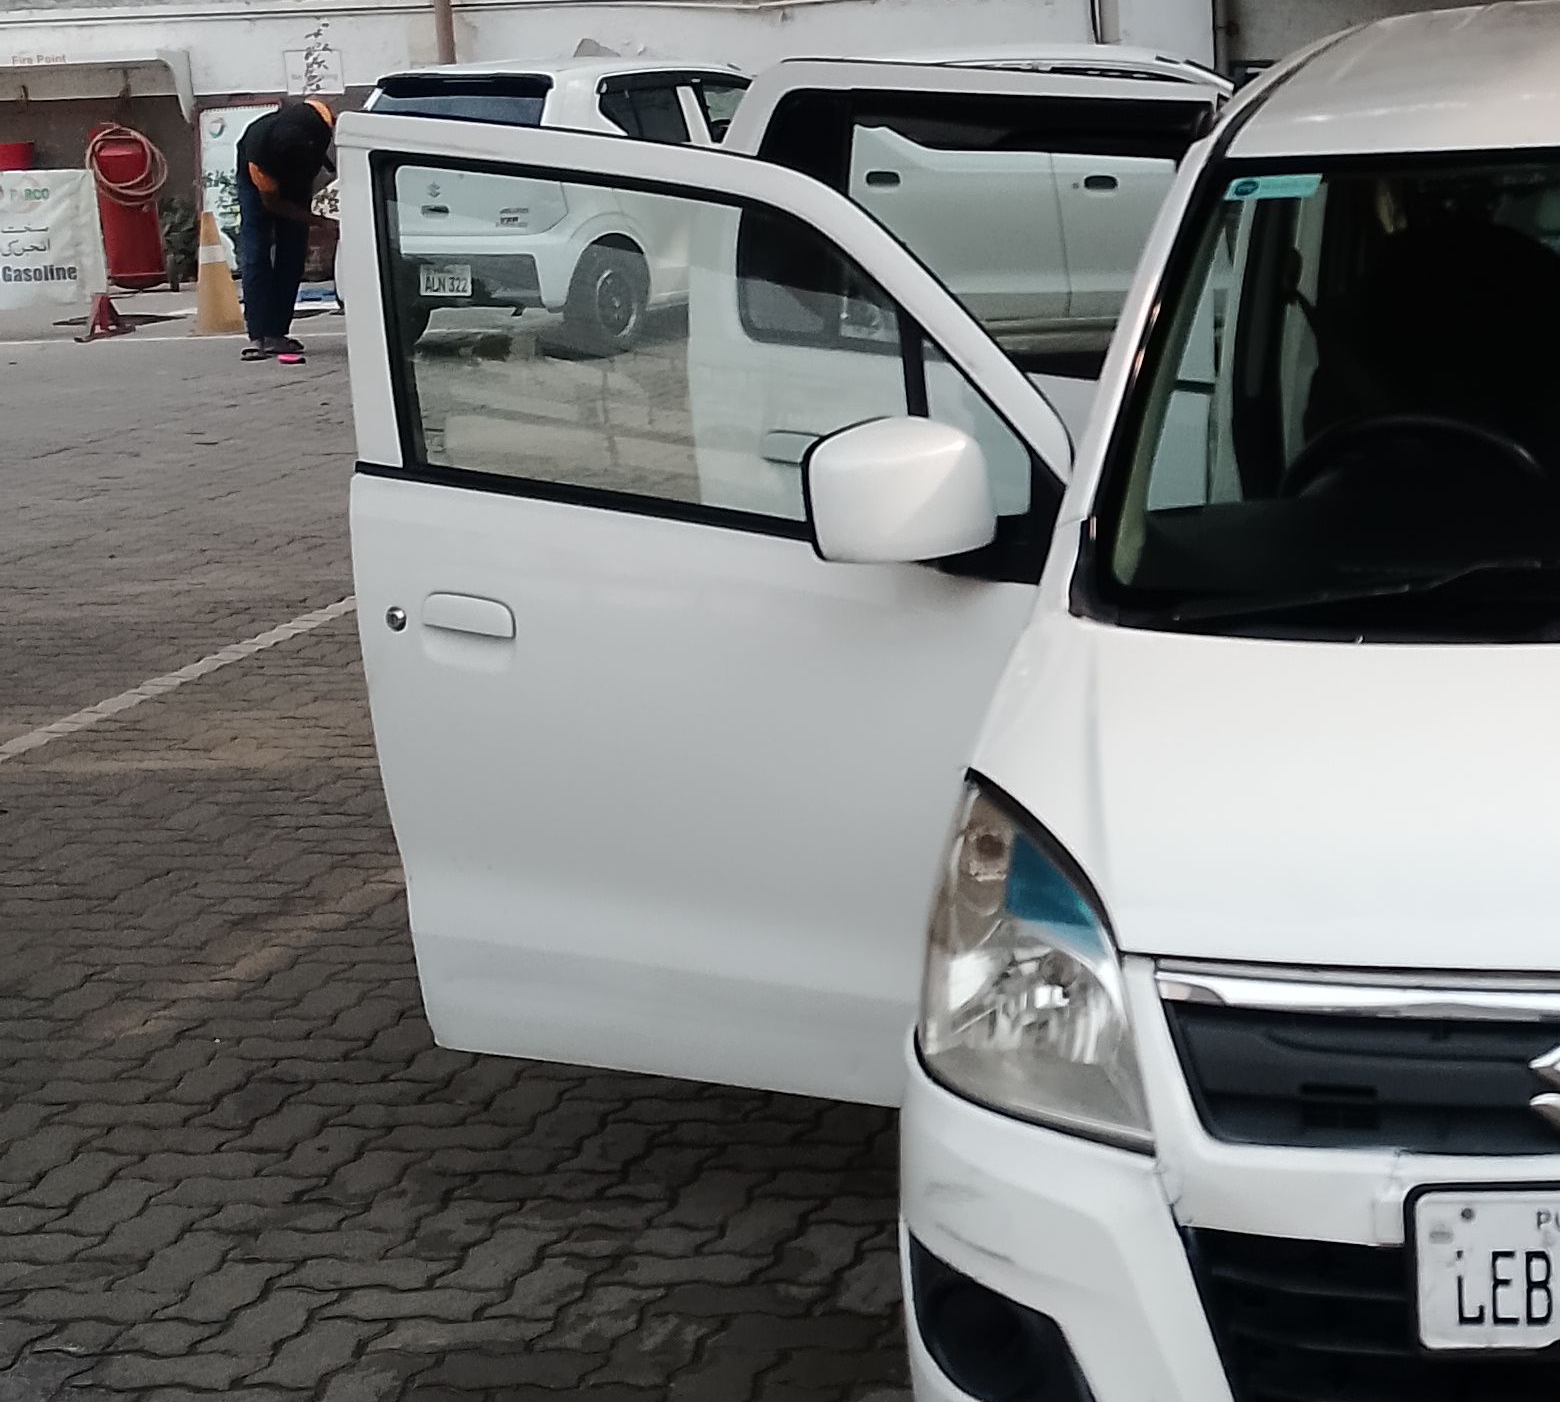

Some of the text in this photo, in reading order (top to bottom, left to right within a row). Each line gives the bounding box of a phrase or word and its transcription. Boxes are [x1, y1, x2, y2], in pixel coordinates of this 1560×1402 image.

[11, 54, 67, 65] Fire Point
[2, 264, 78, 282] Gasoline
[448, 276, 468, 293] 322
[1456, 1249, 1553, 1326] LEB
